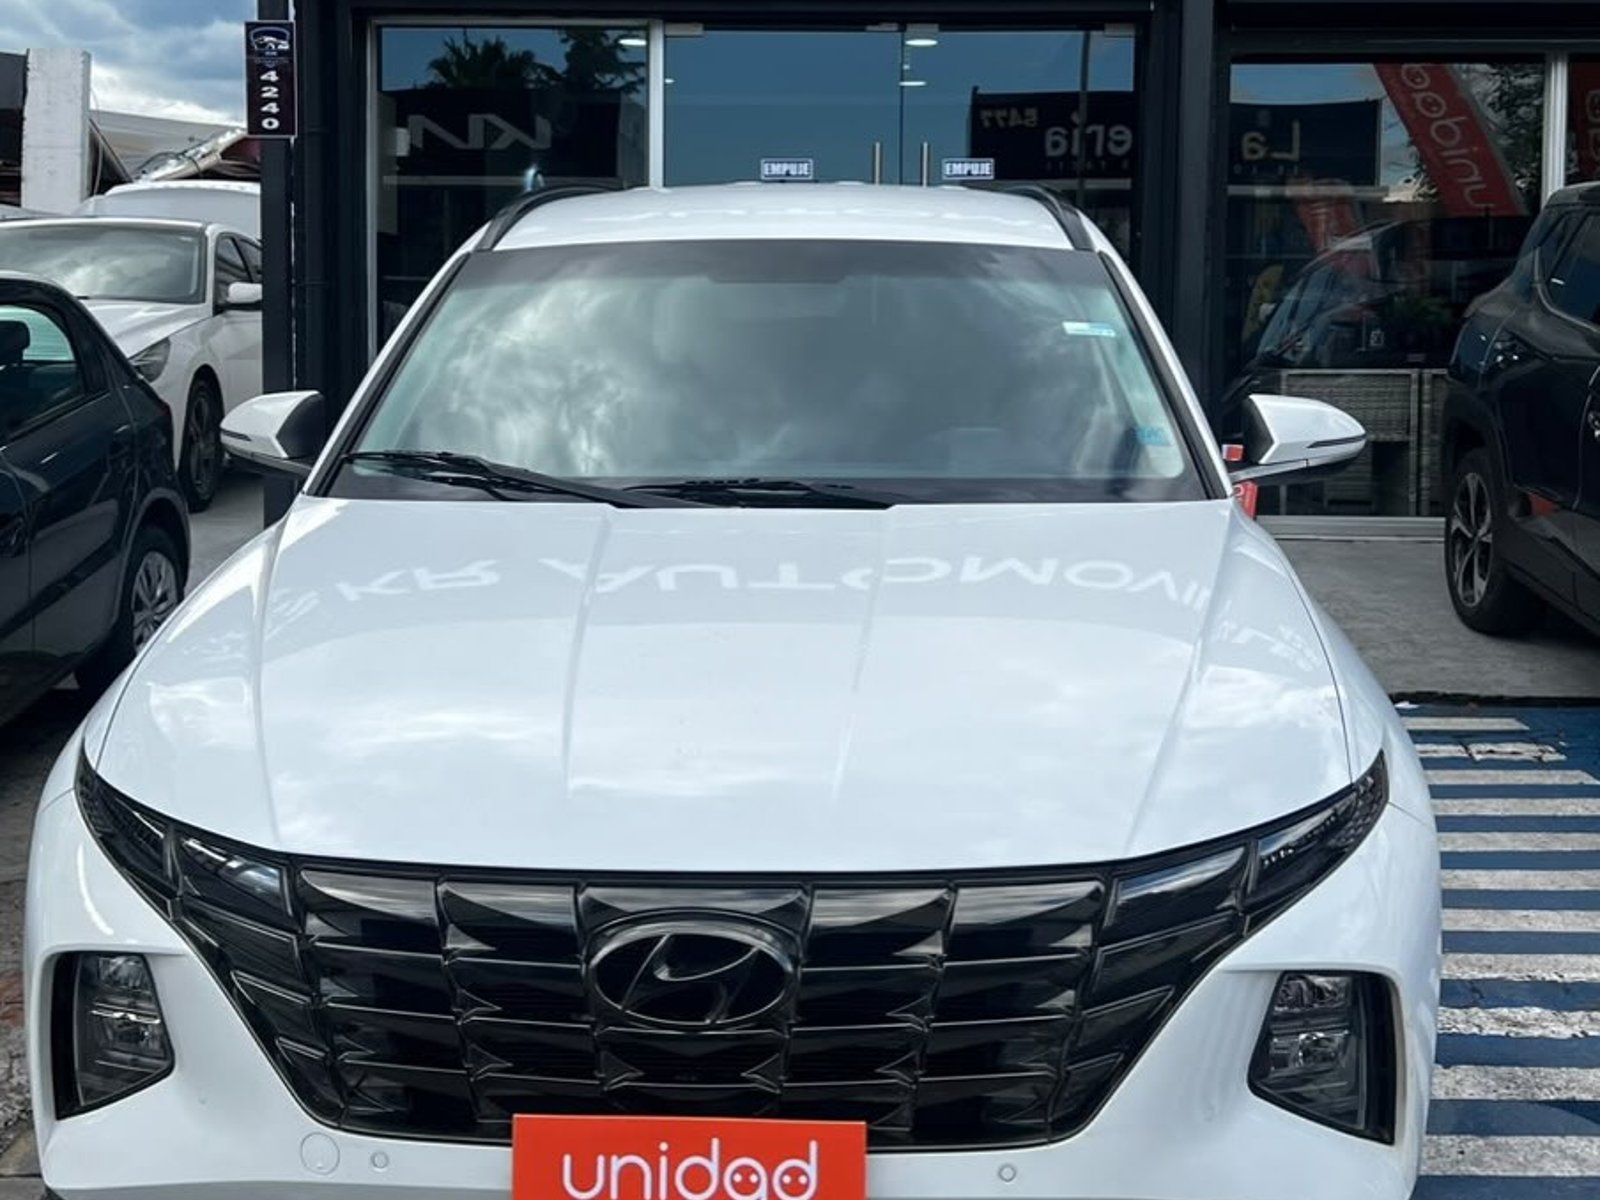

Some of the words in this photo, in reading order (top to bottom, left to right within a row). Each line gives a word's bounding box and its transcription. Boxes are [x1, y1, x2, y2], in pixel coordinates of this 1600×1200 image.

[260, 70, 280, 130] 4240
[764, 162, 809, 176] EMPUJE
[945, 162, 991, 176] EMPUJE
[562, 1137, 819, 1200] unidad
